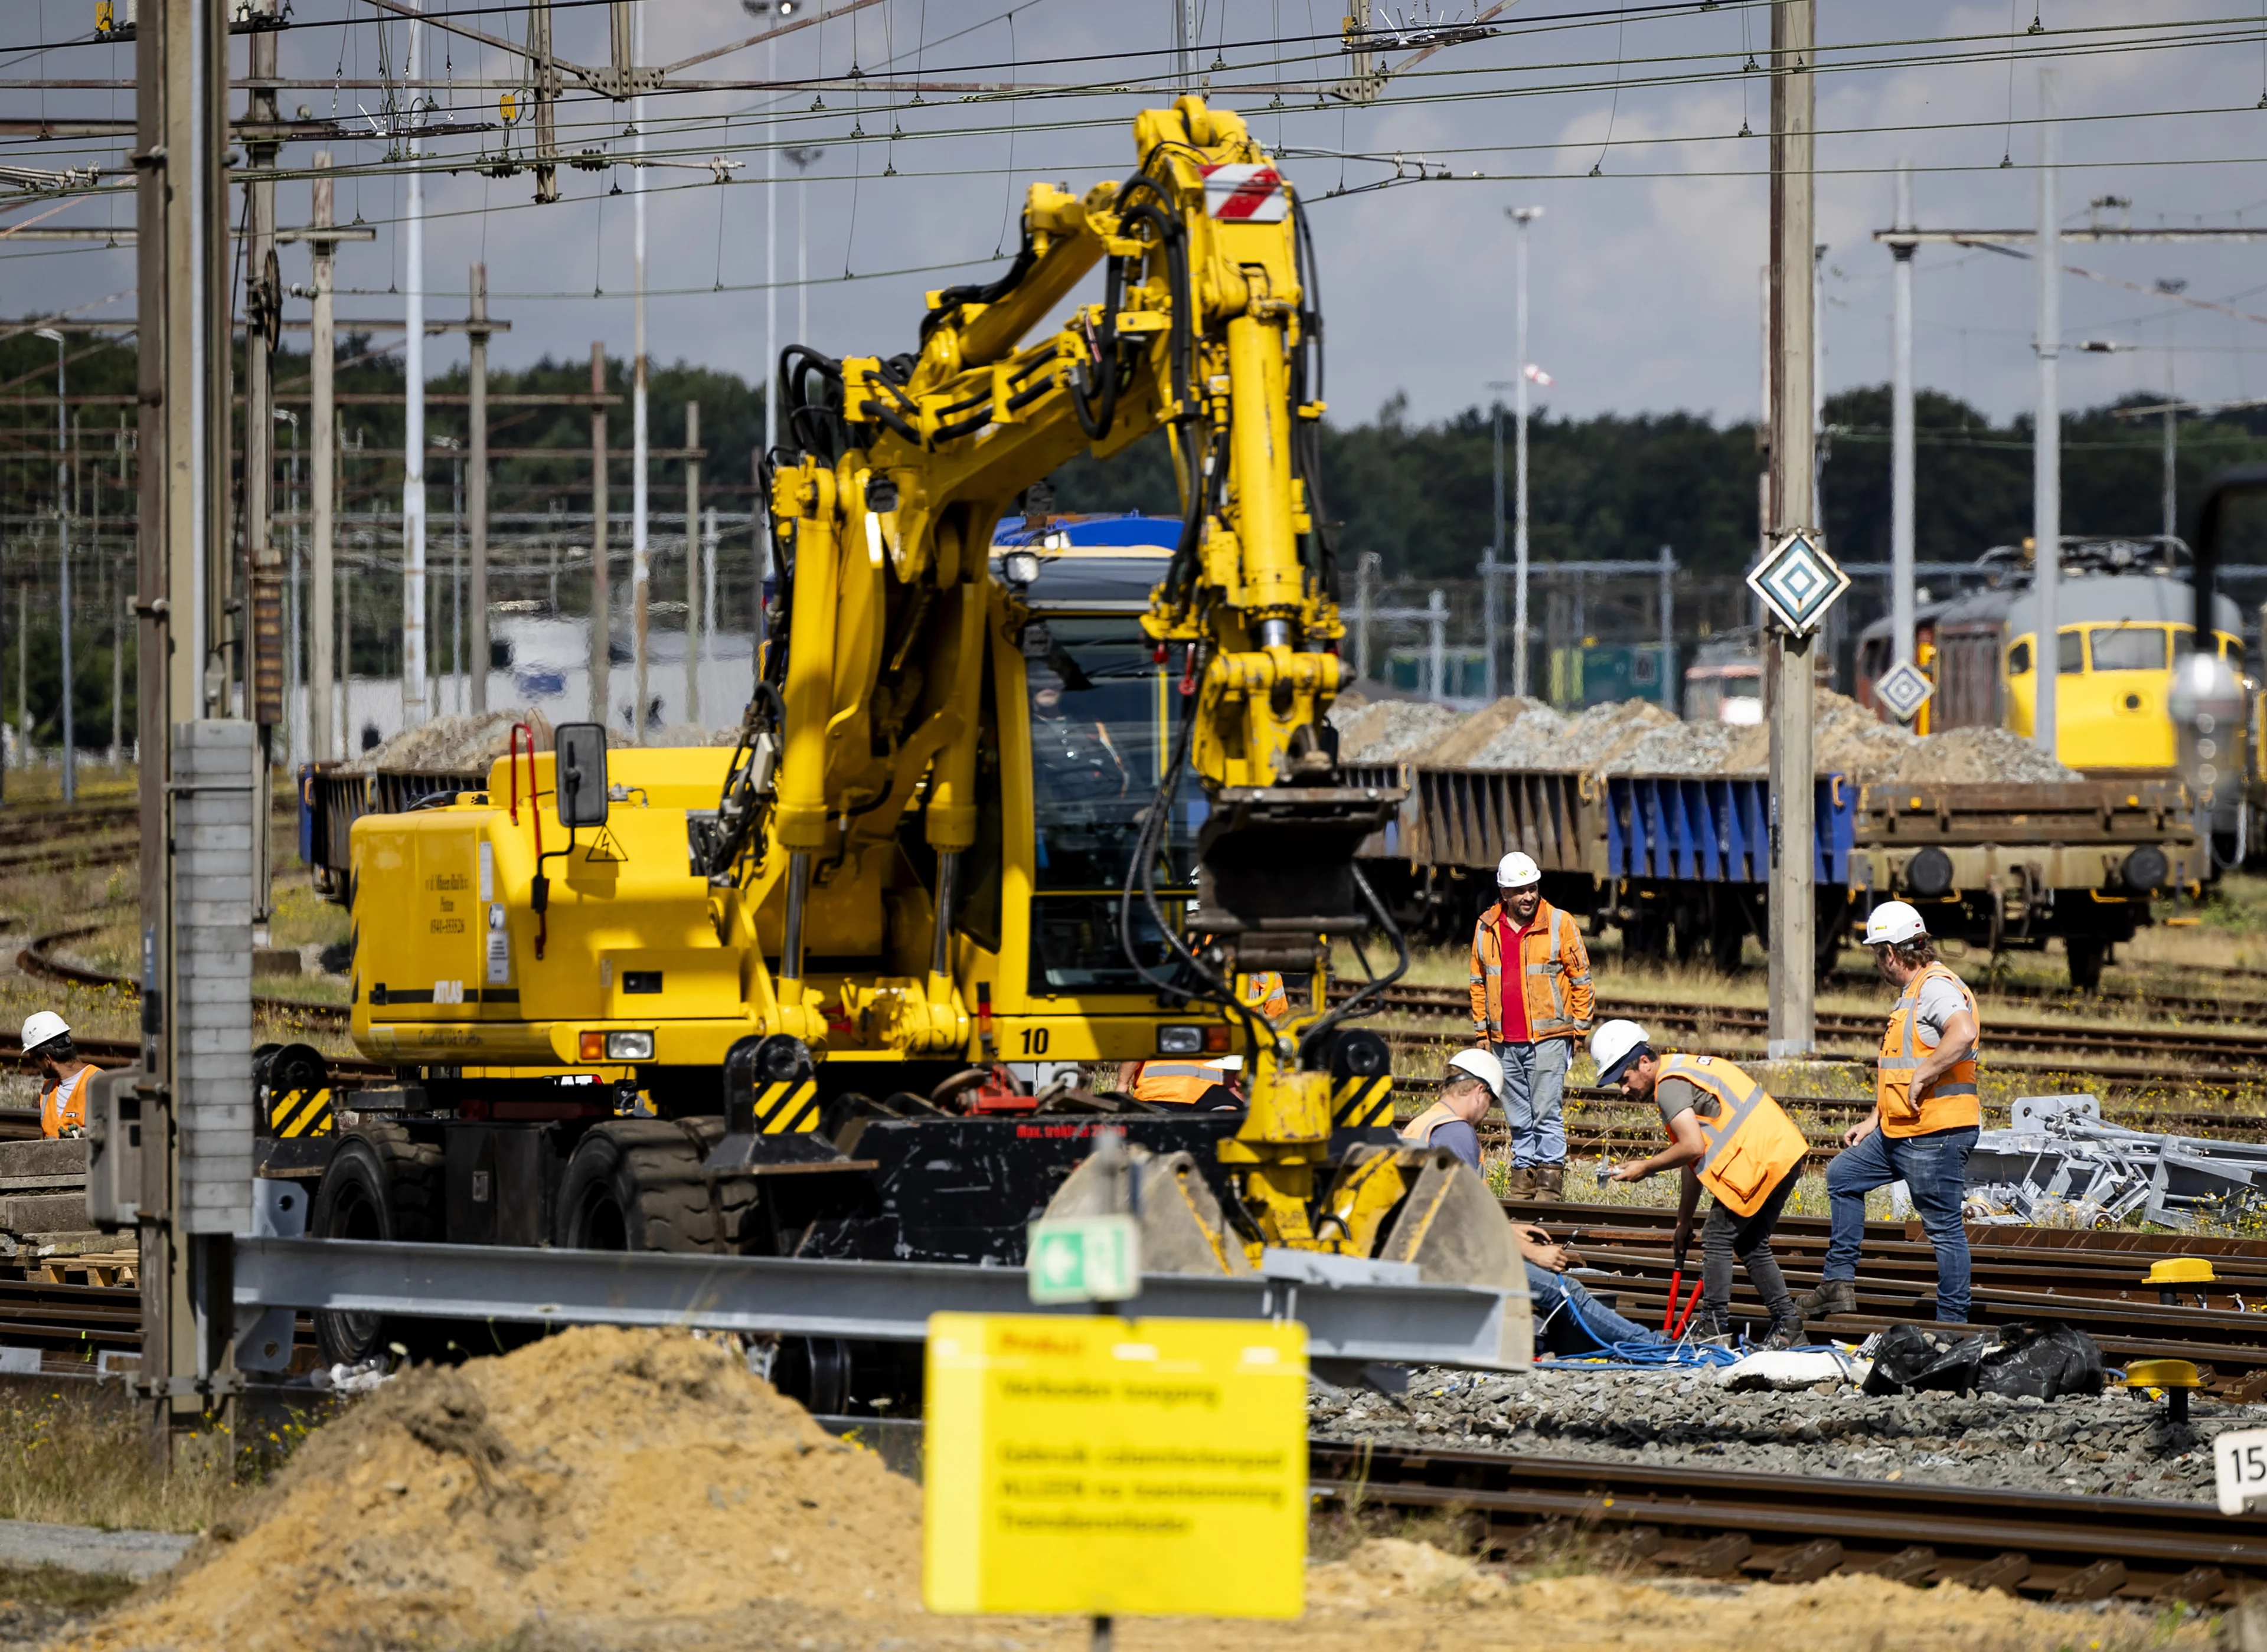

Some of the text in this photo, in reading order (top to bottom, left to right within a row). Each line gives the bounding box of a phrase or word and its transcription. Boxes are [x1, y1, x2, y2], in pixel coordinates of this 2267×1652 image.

[433, 980, 463, 1005] ATLAS
[1020, 1028, 1049, 1055] 10
[1016, 1124, 1043, 1139] Max.
[2231, 1446, 2266, 1484] 15
